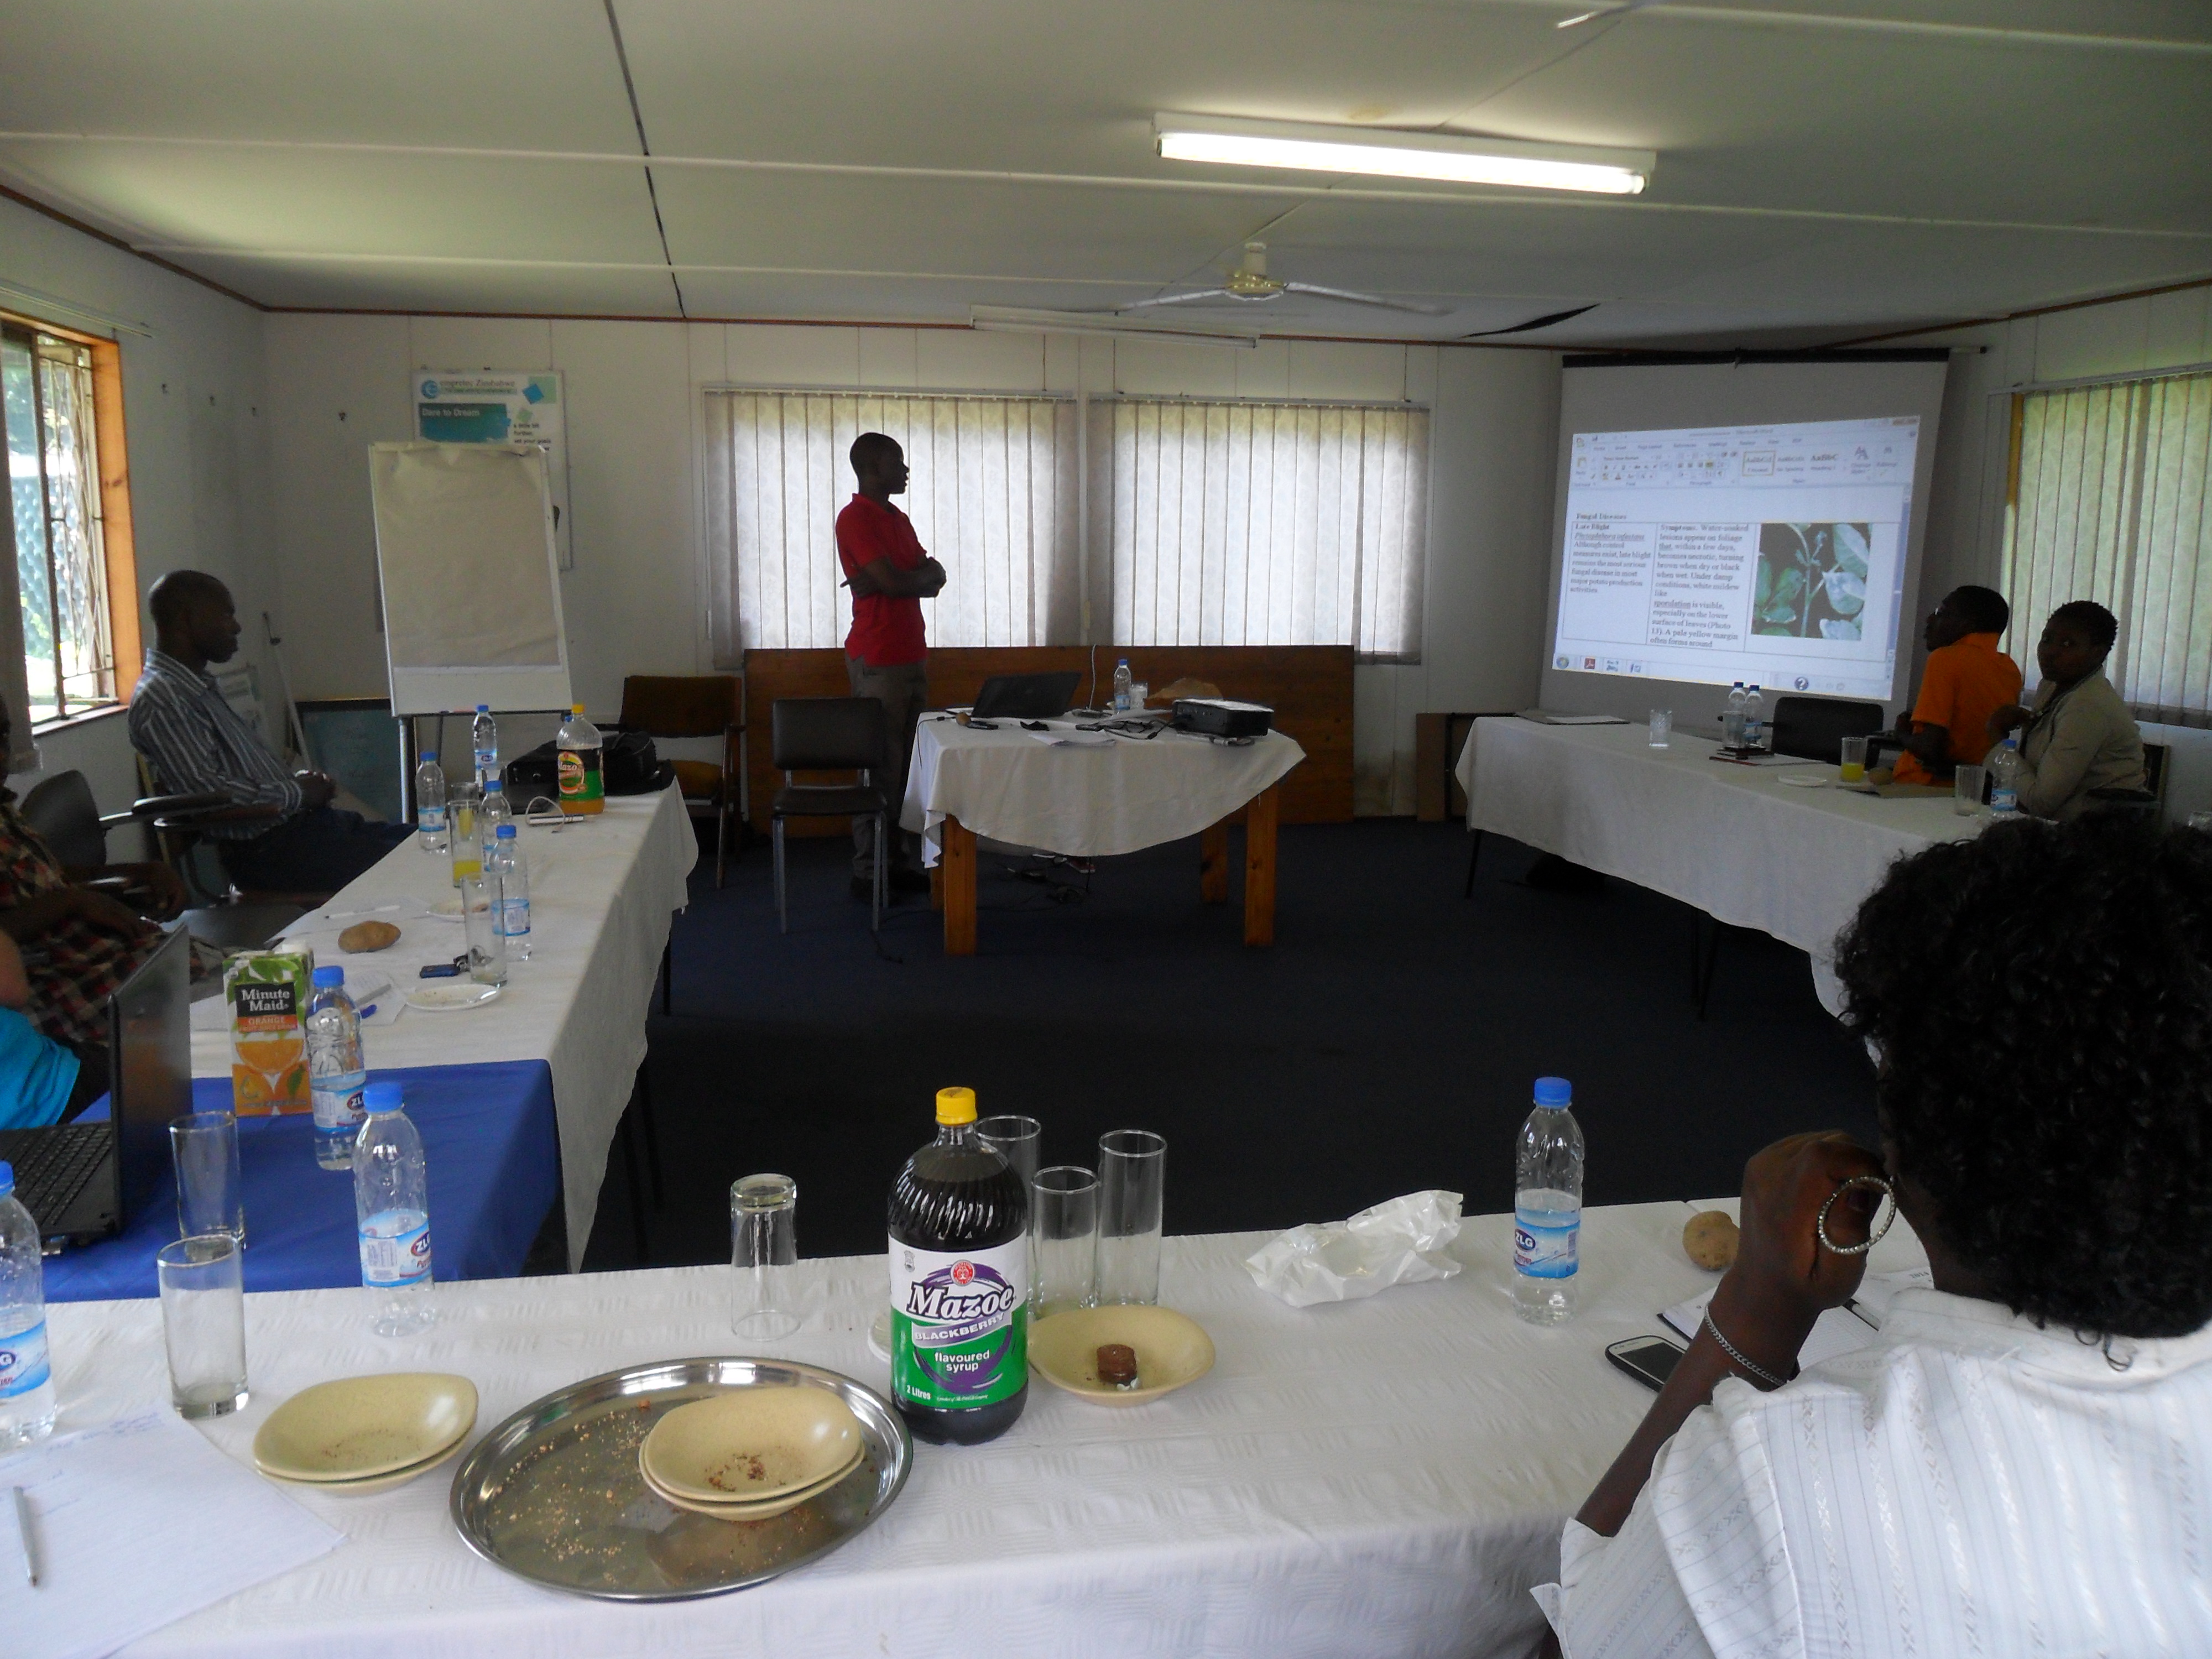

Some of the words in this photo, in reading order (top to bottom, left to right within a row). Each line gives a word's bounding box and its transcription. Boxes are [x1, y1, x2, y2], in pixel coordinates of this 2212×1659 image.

[1718, 544, 1735, 552] days,
[1714, 573, 1733, 581] damp
[241, 988, 290, 1001] Minute
[249, 999, 284, 1012] Maid
[352, 1096, 363, 1107] ZL
[1516, 1232, 1533, 1248] ZLG
[906, 1281, 1015, 1320] Mazoe
[914, 1312, 1005, 1341] BLACKBERRY
[934, 1349, 990, 1363] flavoured
[946, 1362, 979, 1374] syrup
[907, 1385, 911, 1394] 2
[912, 1386, 931, 1400] Litres
